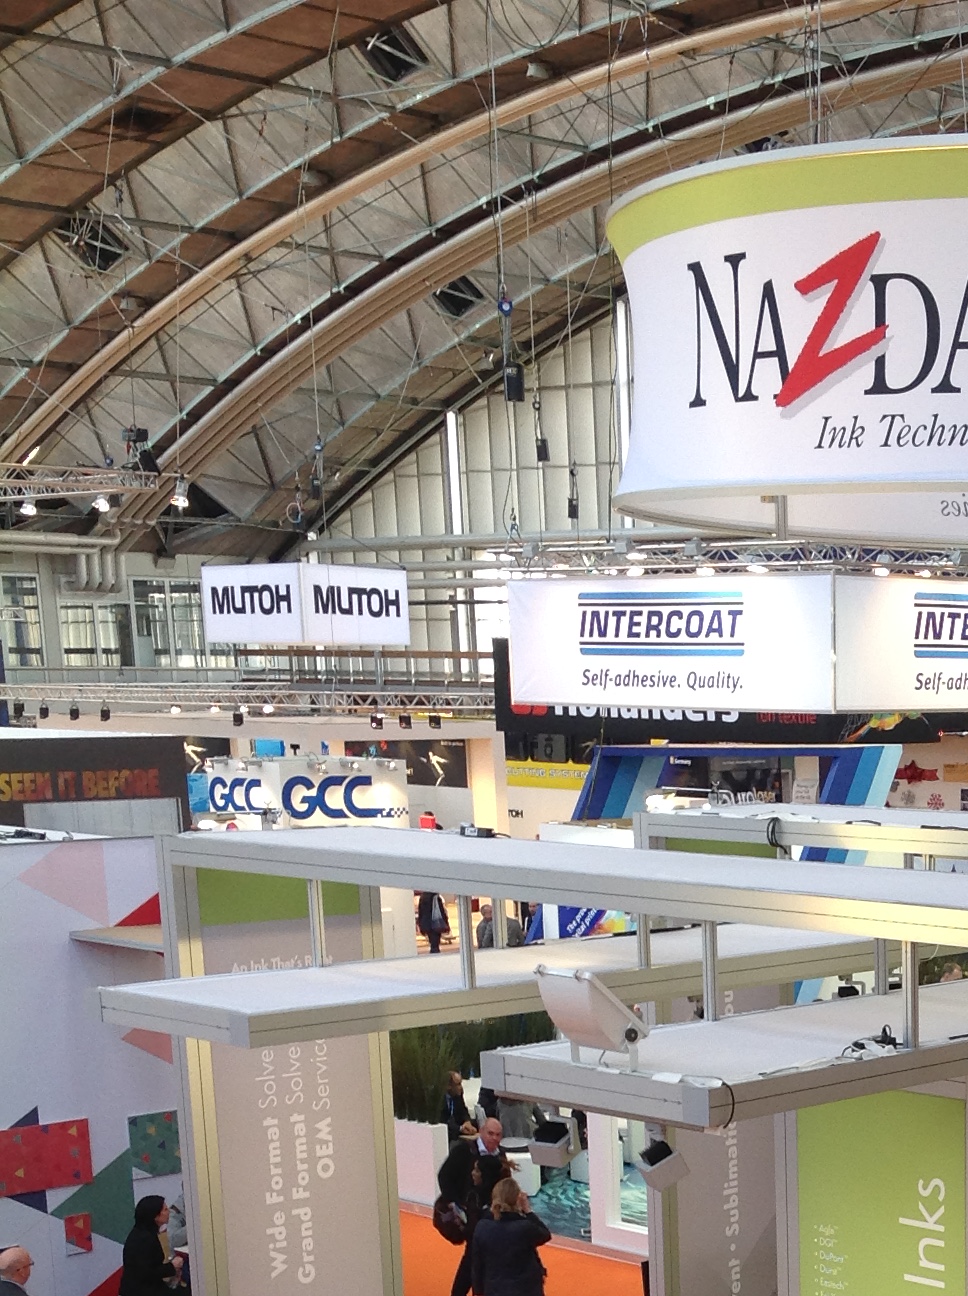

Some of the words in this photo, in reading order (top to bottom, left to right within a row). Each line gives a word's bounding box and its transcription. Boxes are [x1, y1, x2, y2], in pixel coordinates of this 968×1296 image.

[814, 415, 864, 450] Ink
[210, 584, 292, 615] MUTOH
[312, 585, 401, 618] MUTOH
[580, 610, 743, 638] INTERCOAT
[582, 669, 681, 691] Self-adhesive.
[687, 671, 743, 693] Quality.
[0, 771, 53, 801] SEEN
[57, 770, 76, 799] IT
[82, 769, 161, 798] BEFORE
[209, 776, 272, 812] GCC
[282, 775, 394, 820] GCC
[255, 1049, 278, 1109] Solve
[282, 1046, 304, 1104] Solve
[310, 1039, 331, 1110] Servic
[262, 1116, 284, 1204] Format
[289, 1113, 311, 1200] Format
[315, 1117, 335, 1179] OEM
[723, 1121, 740, 1237] Sublimati
[266, 1210, 288, 1279] Wide
[292, 1207, 315, 1284] Grand
[899, 1177, 946, 1289] Inks
